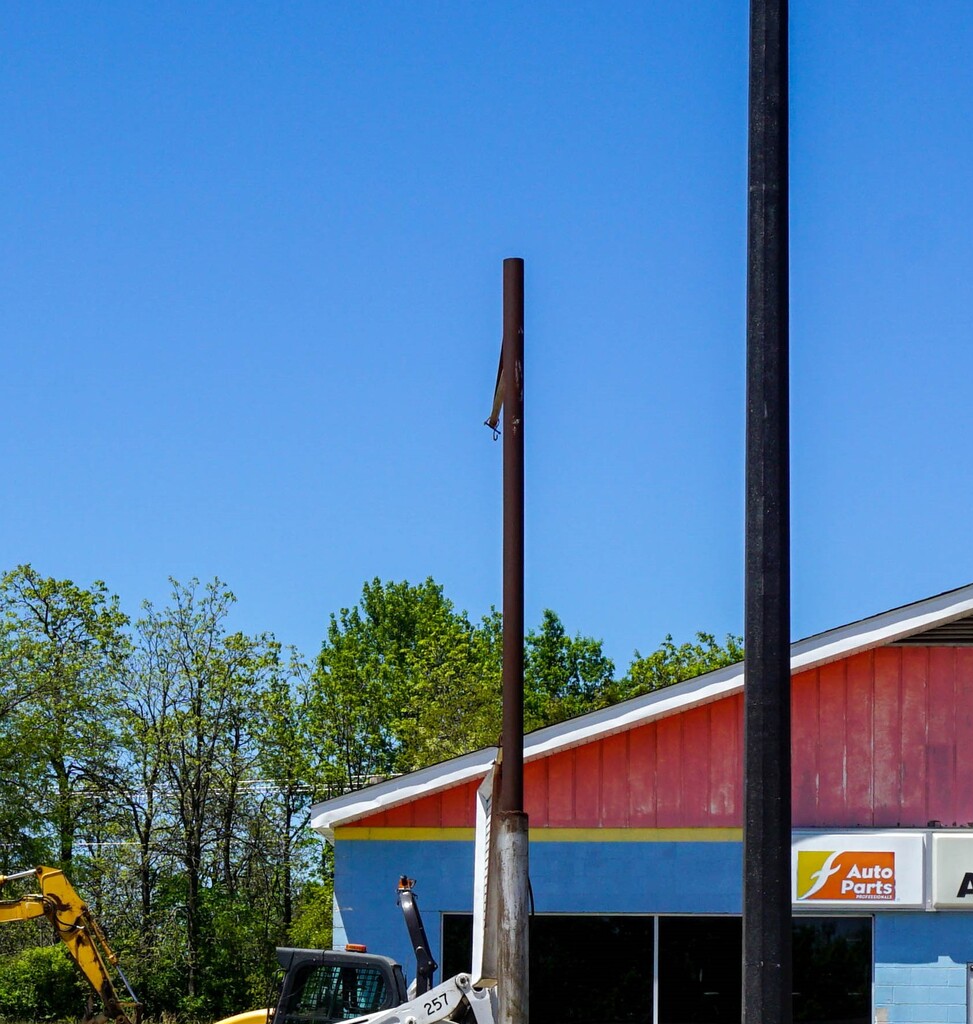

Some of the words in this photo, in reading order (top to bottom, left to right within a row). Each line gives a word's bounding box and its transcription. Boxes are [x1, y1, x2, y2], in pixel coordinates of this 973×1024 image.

[846, 864, 893, 879] Auto
[841, 880, 892, 894] Parts
[424, 993, 448, 1015] 257
